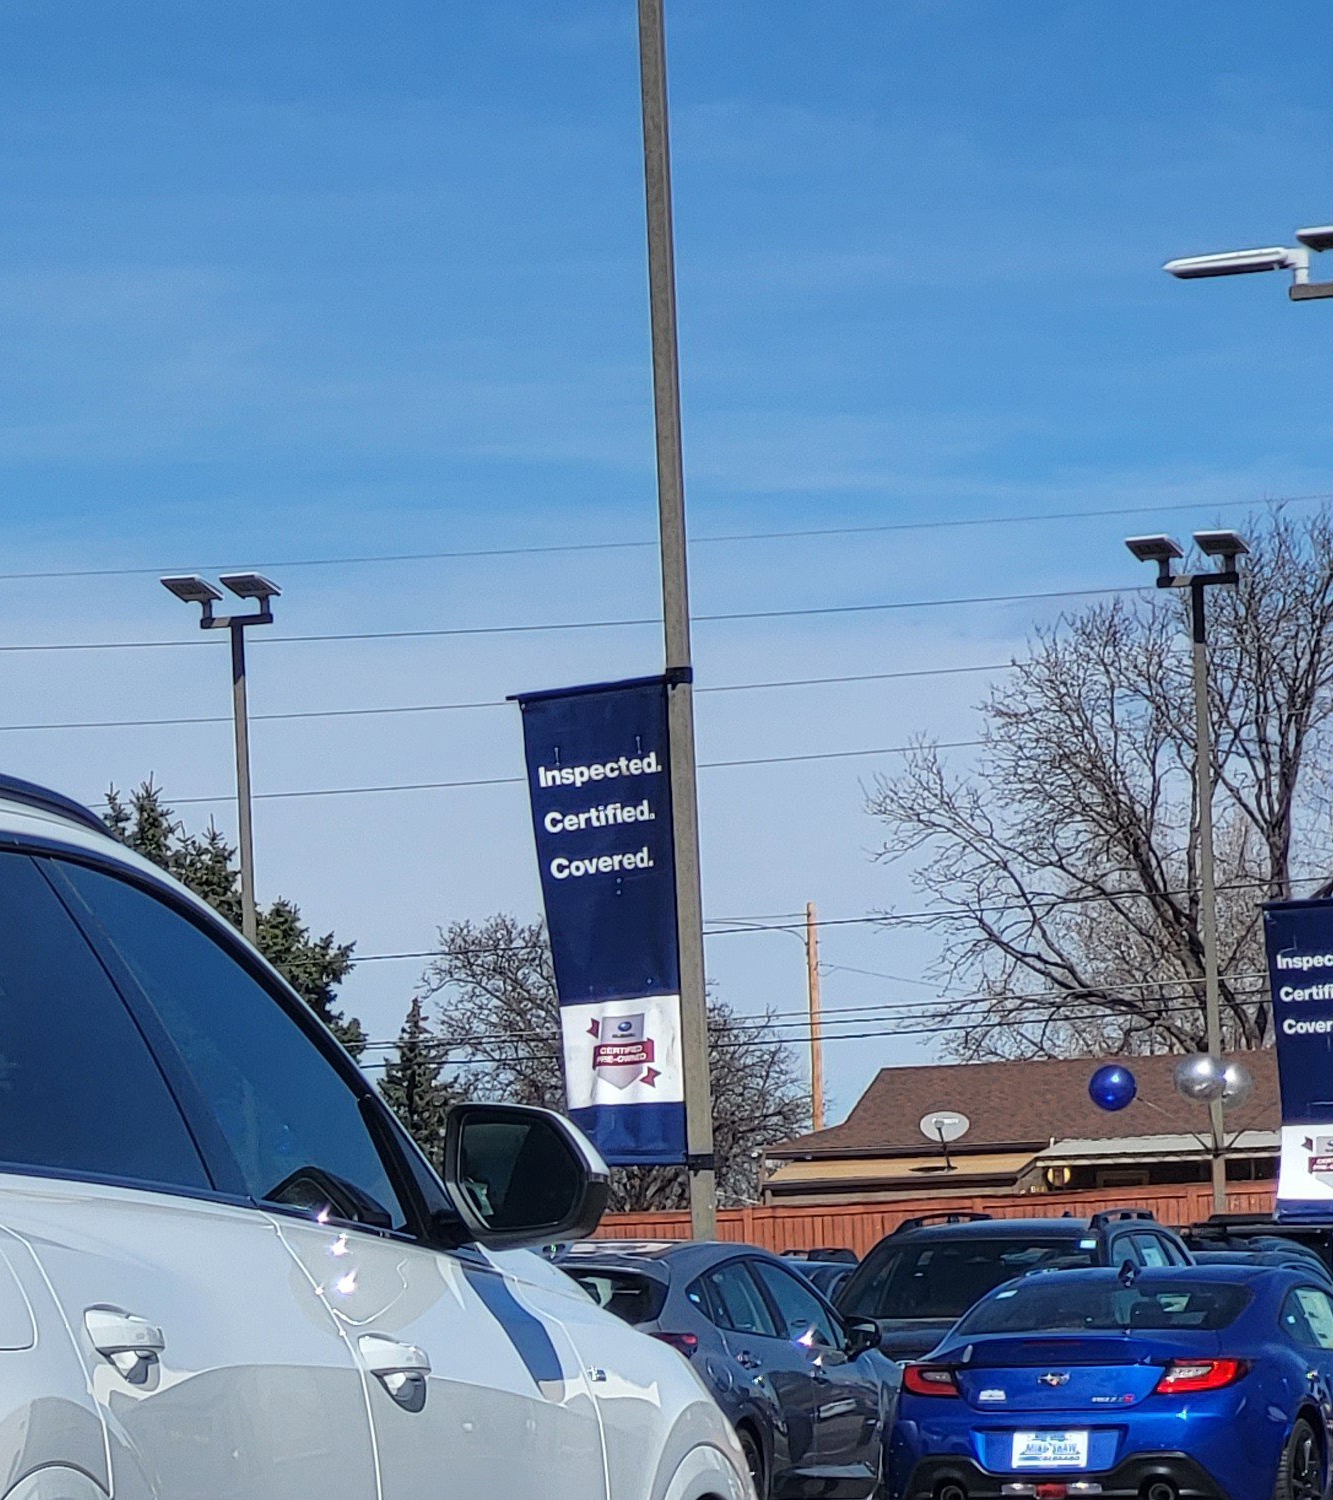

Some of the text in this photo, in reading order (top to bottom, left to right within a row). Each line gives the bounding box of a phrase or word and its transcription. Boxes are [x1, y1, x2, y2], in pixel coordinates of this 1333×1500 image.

[538, 751, 662, 788] Inspected.
[544, 799, 655, 834] Certified.
[550, 846, 654, 880] Covered.
